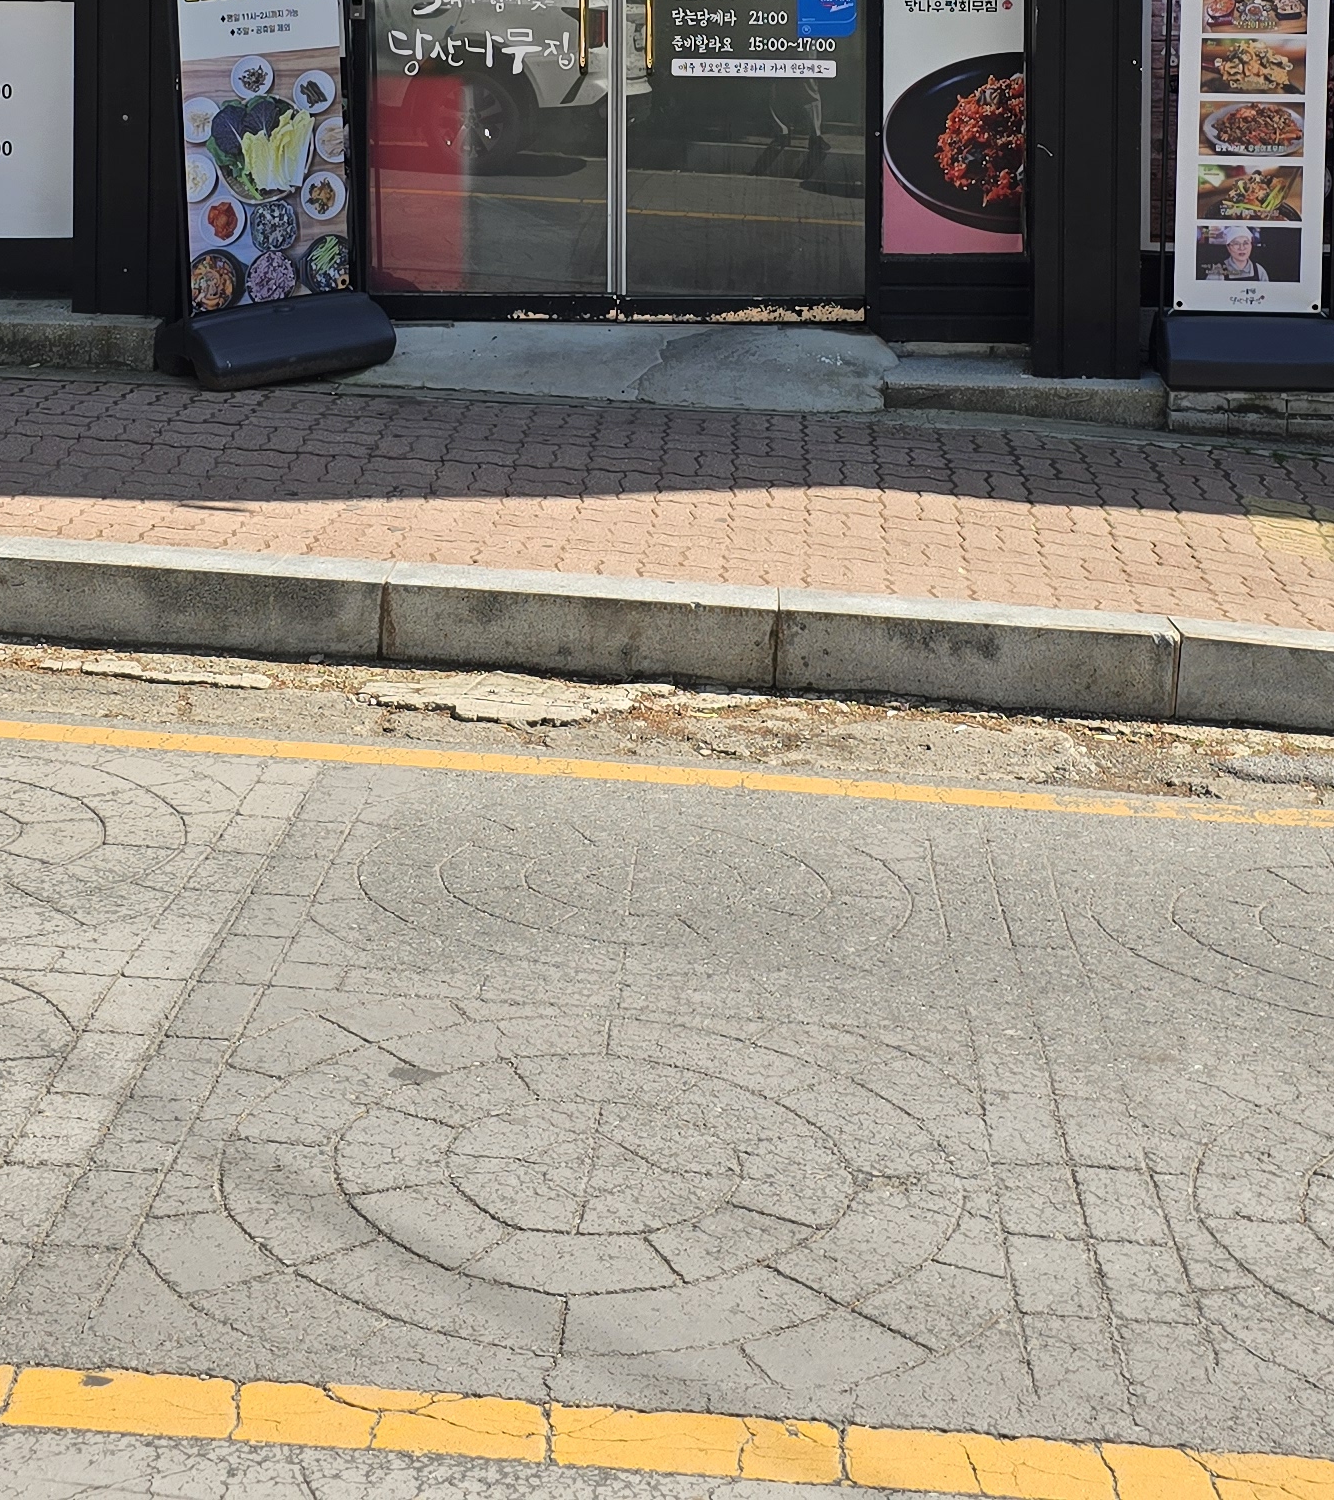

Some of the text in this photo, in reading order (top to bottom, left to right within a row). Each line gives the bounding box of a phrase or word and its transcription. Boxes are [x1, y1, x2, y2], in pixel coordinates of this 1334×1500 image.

[672, 9, 788, 26] 닫는당께라 21:00
[388, 28, 575, 76] 당산나무집
[672, 35, 836, 53] 준비할라요 15:00~17:00
